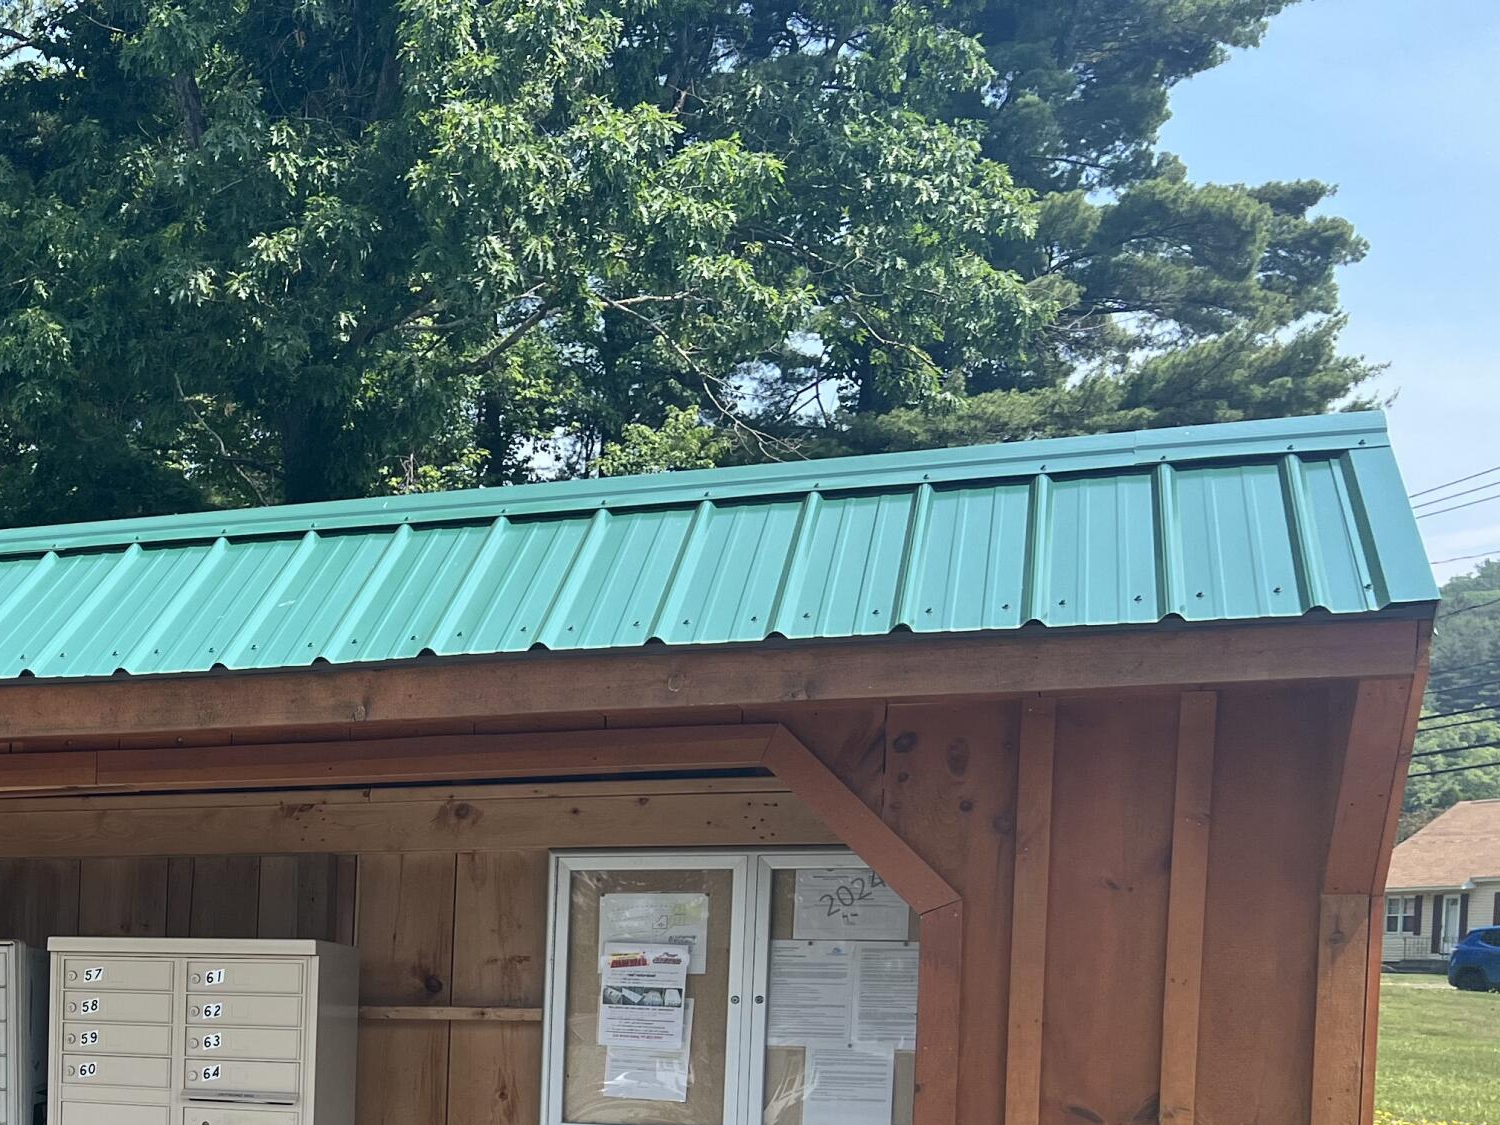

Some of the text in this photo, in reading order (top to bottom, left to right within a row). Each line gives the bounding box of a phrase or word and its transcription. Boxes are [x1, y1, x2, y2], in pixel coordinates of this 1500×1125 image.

[84, 968, 103, 981] 57
[206, 970, 223, 984] 61
[82, 999, 99, 1013] 58
[203, 1004, 221, 1017] 62
[81, 1031, 98, 1044] 59
[203, 1035, 221, 1048] 63
[79, 1063, 96, 1076] 60
[203, 1066, 220, 1079] 64
